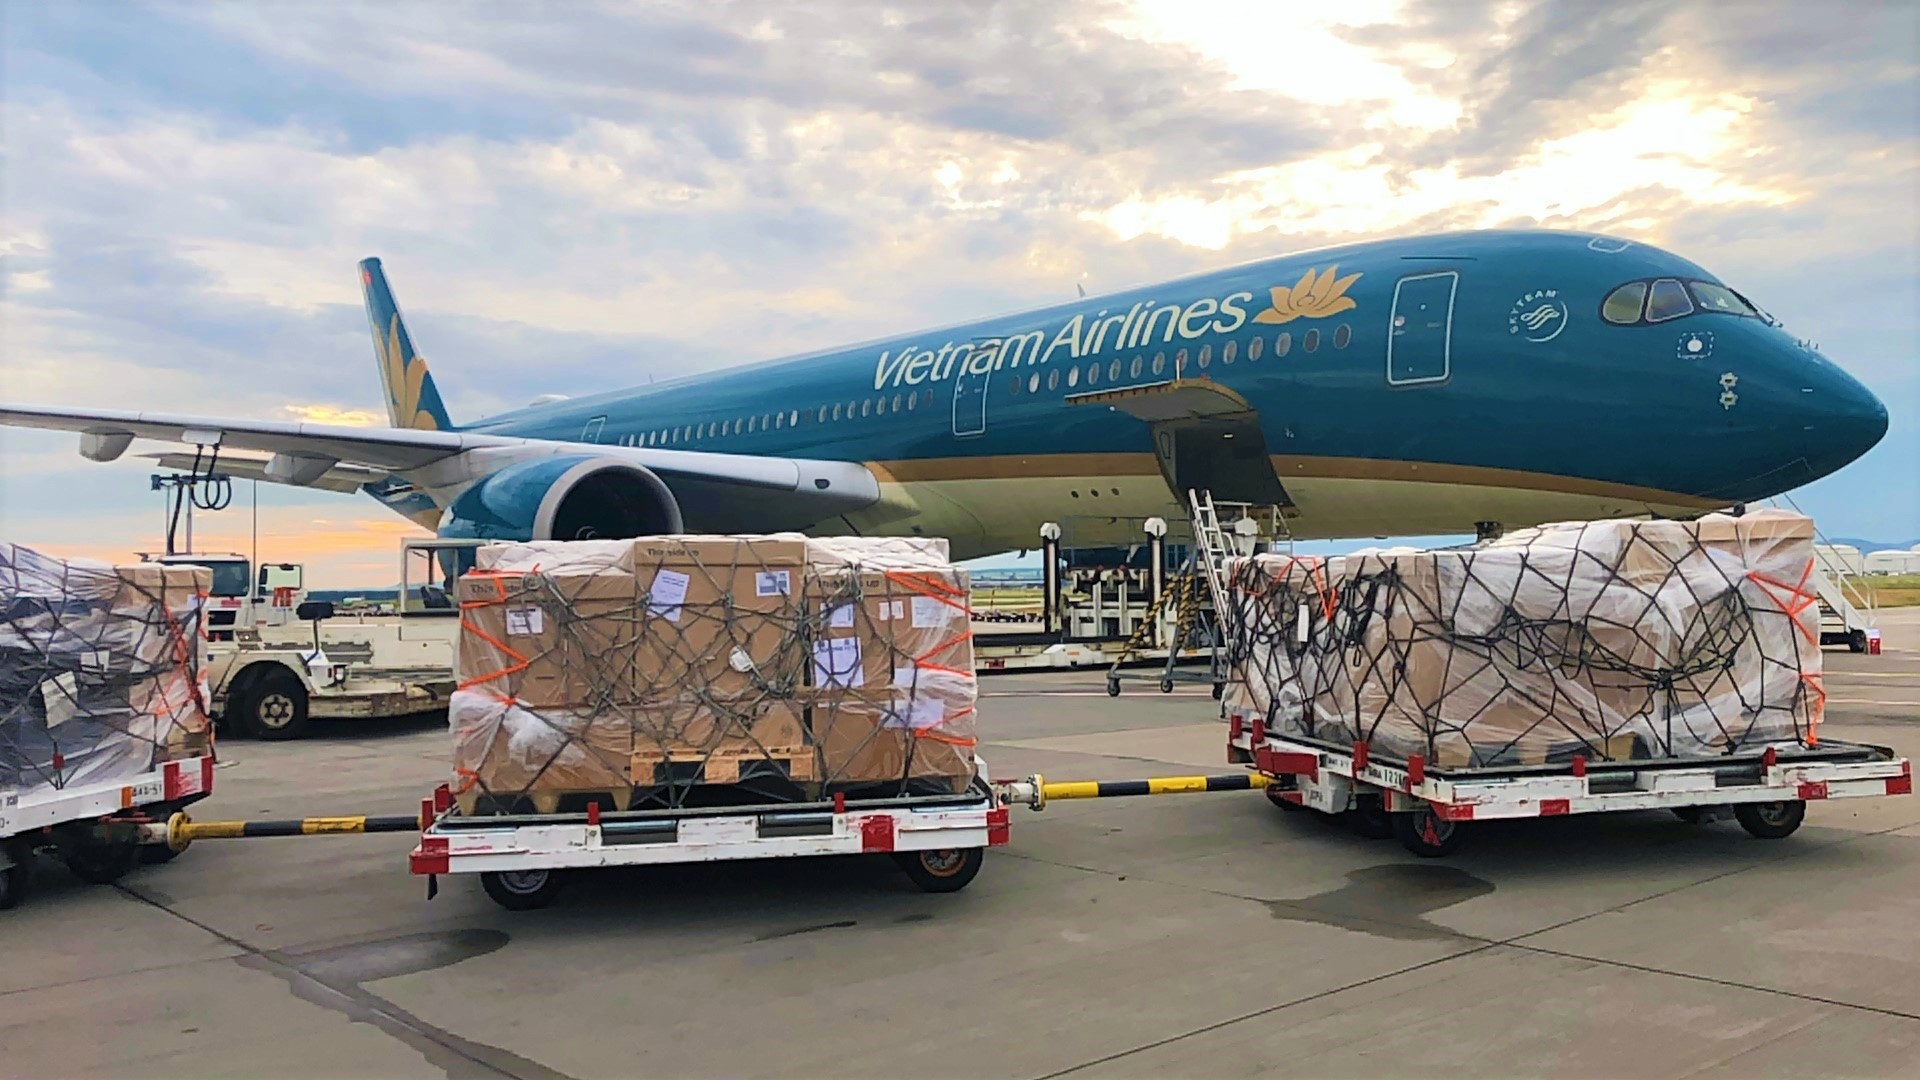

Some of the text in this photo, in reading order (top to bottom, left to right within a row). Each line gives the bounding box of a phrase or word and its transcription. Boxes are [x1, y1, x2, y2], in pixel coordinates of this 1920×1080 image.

[873, 291, 1253, 391] Vietnam Airlines
[1508, 289, 1557, 335] SKYTEAM
